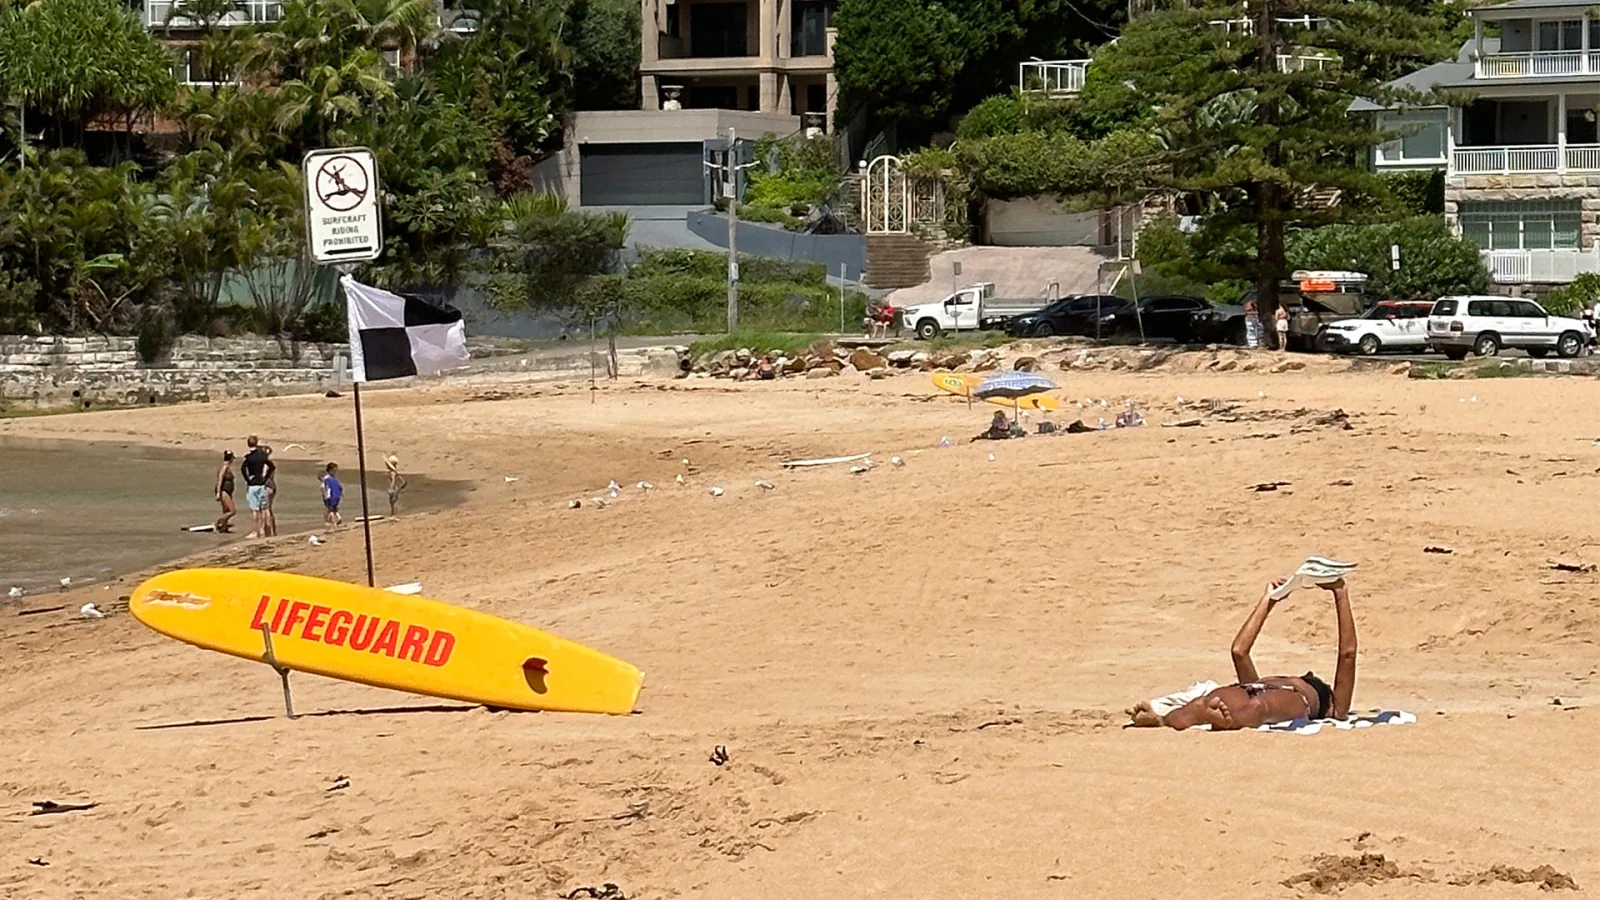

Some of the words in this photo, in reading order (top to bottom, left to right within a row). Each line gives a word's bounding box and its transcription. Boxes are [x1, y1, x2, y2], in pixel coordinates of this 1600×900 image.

[332, 225, 359, 235] RIDING
[323, 236, 368, 246] PROHIBITED
[250, 595, 456, 667] LIFEGUARD
